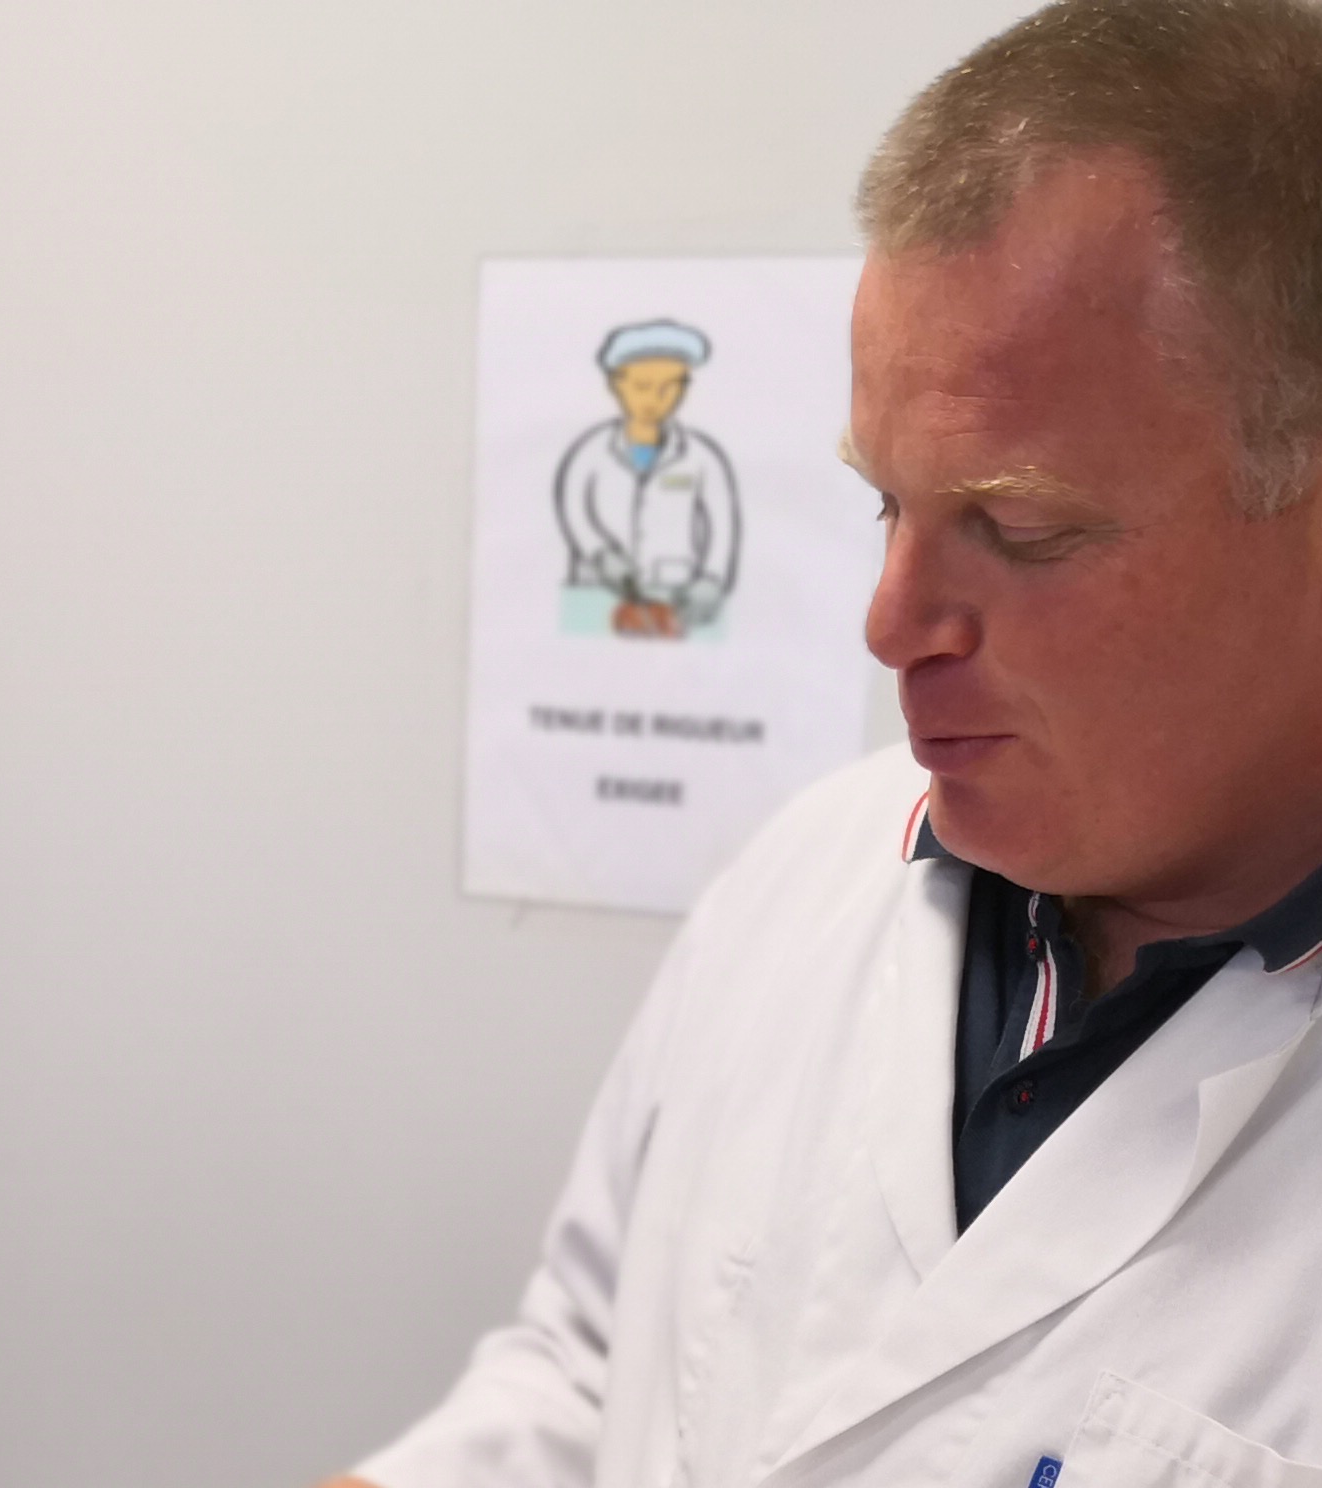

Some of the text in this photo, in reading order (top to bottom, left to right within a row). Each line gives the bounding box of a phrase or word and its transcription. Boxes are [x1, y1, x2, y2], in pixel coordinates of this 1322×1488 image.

[528, 704, 766, 745] TENUE DE RIGUEUR
